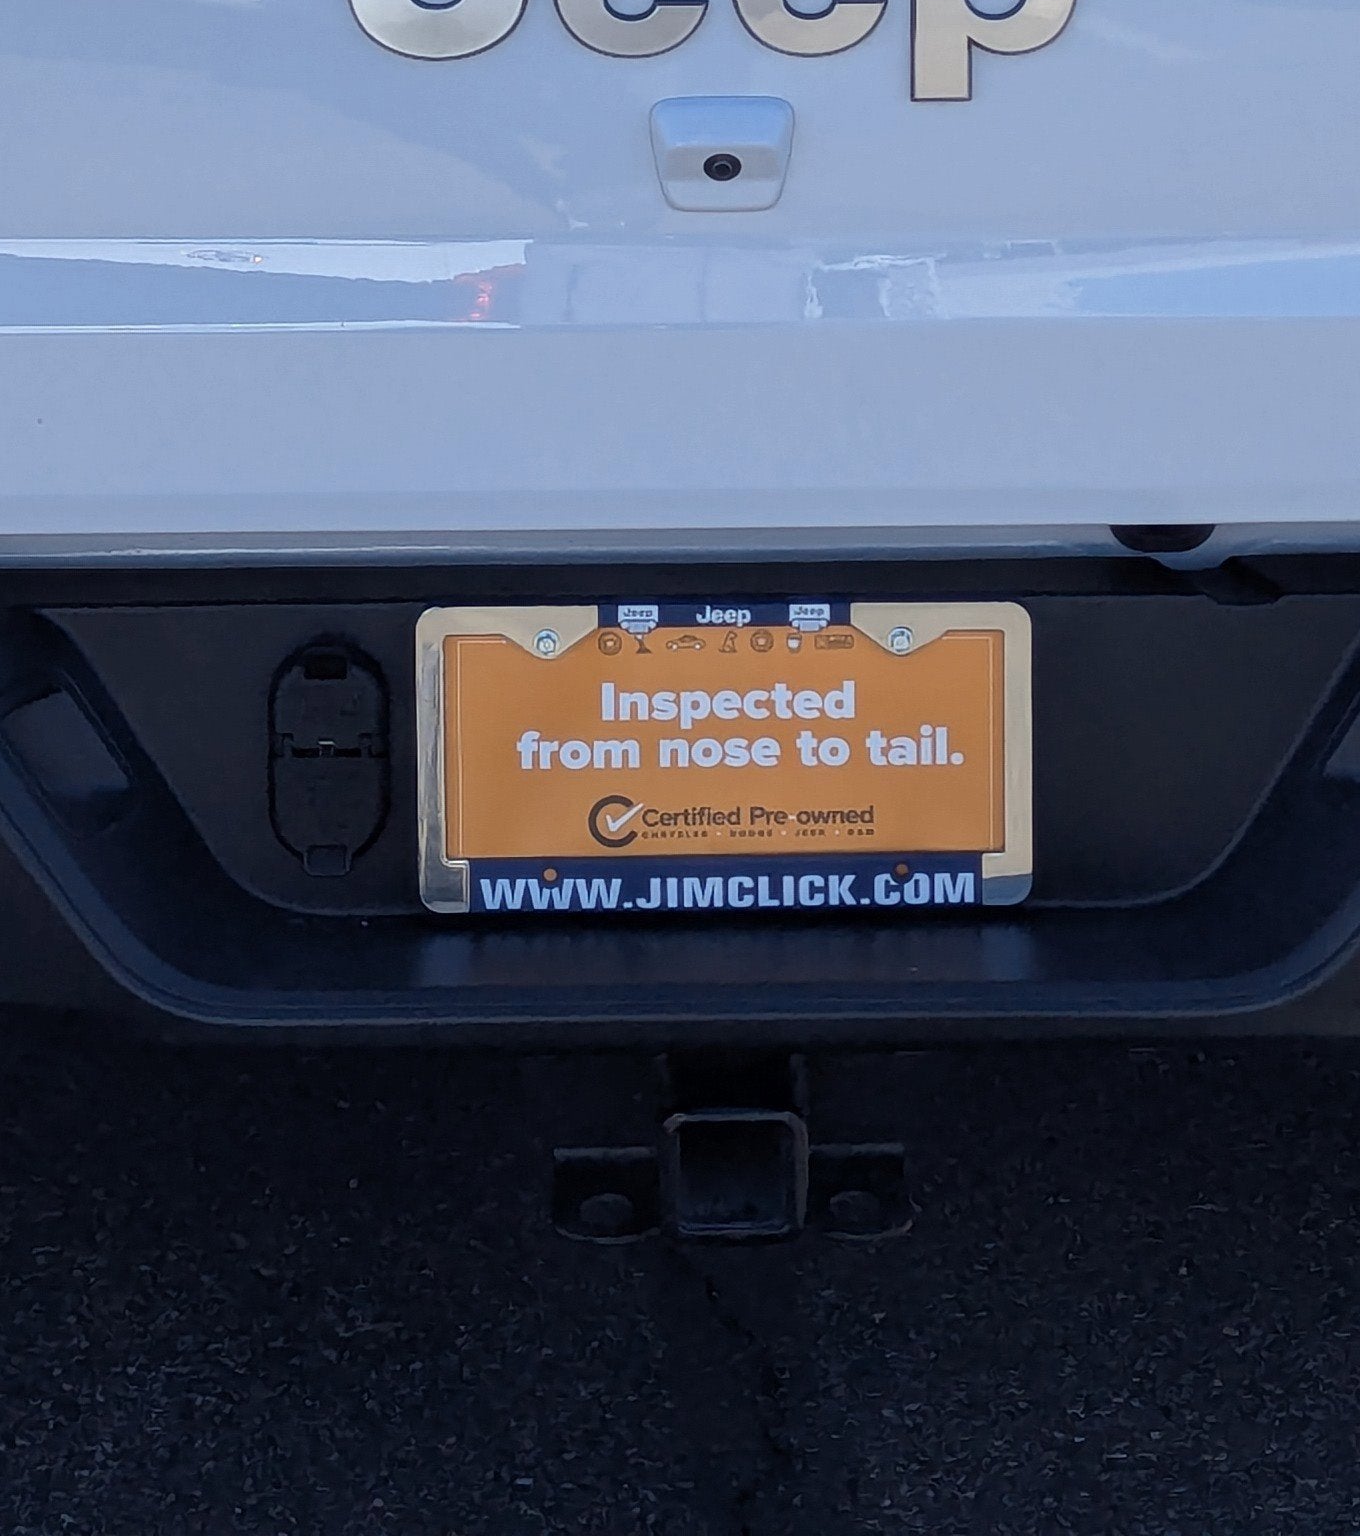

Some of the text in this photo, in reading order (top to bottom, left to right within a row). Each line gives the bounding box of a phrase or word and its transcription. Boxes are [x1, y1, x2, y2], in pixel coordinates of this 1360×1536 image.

[696, 605, 752, 627] Jeep
[601, 680, 856, 730] Inspected
[517, 724, 965, 769] from nose to tail.
[641, 805, 875, 828] Certified Pre-owned
[480, 872, 976, 910] WWW.JIMCLICK.COM
